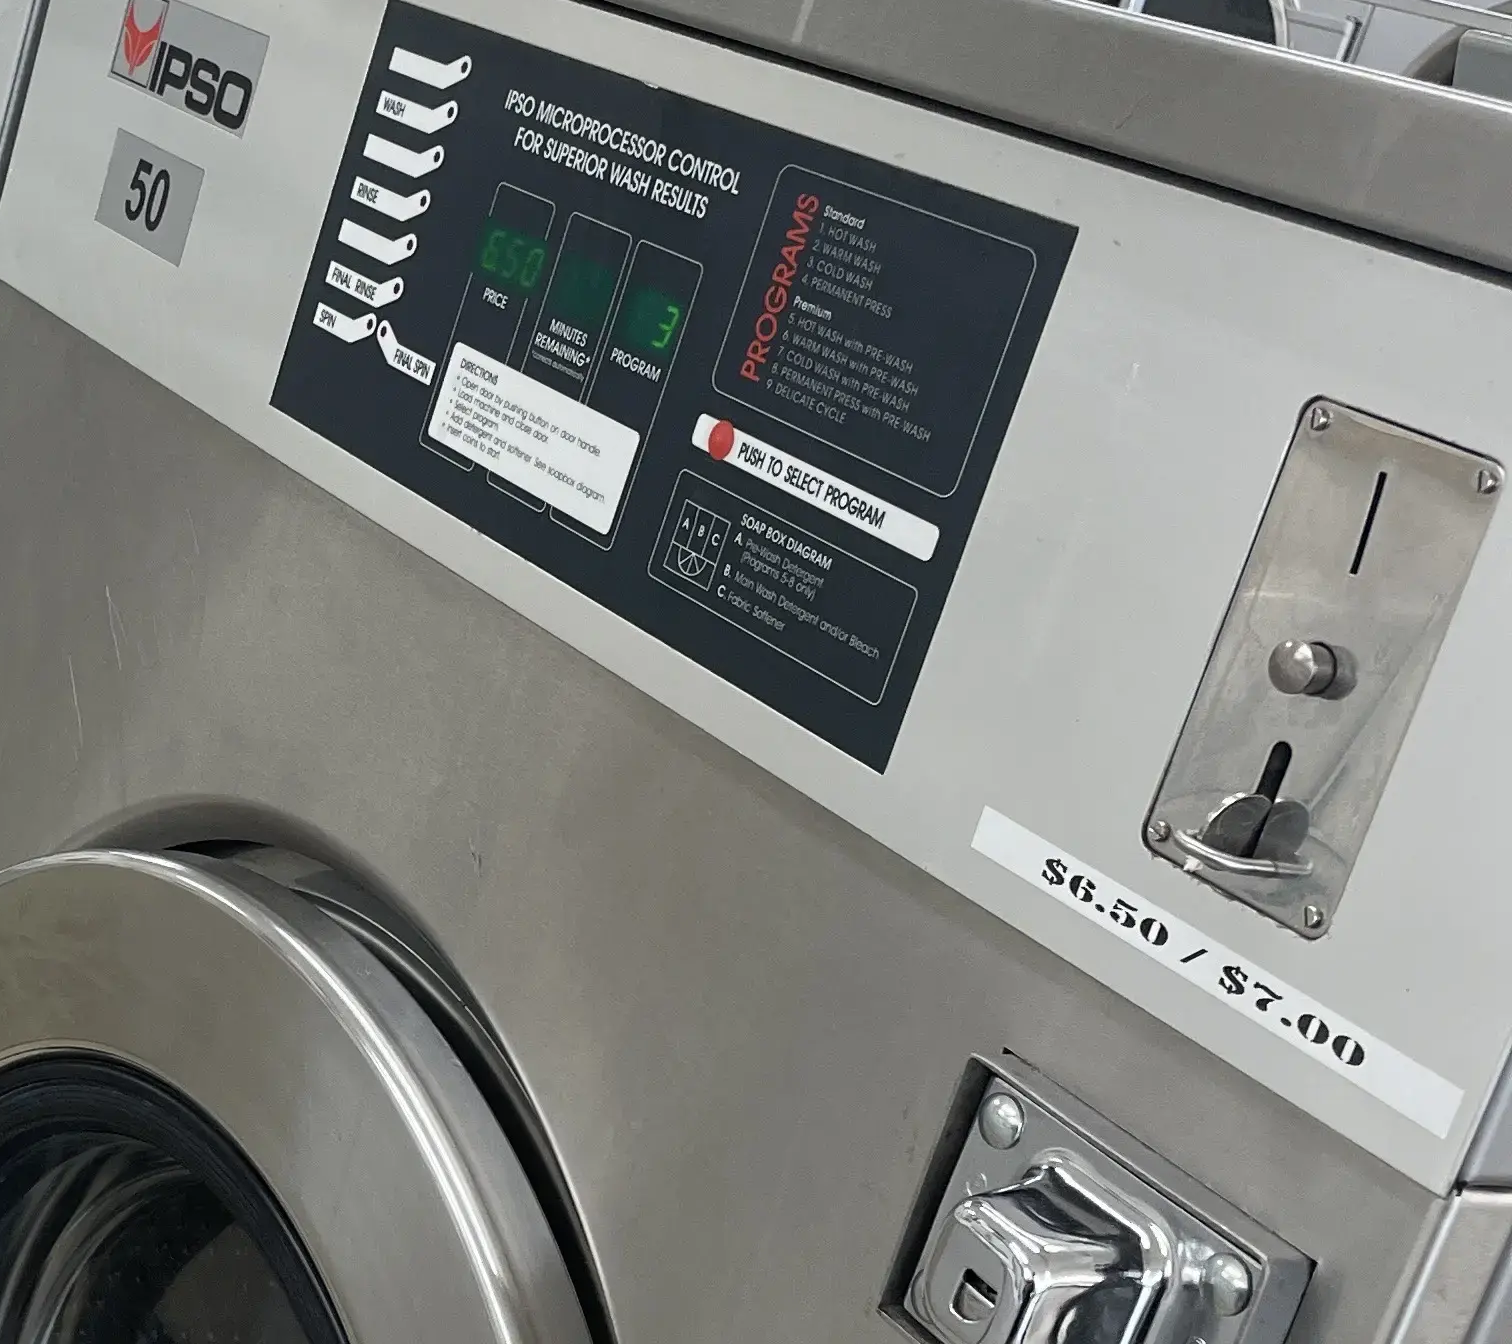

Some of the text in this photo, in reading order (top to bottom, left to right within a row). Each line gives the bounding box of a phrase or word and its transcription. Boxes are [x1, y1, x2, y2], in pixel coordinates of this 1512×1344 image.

[148, 41, 253, 131] IPSO
[382, 97, 405, 117] WASH
[504, 89, 743, 194] IPSO MICROPROCESSOR CONTROL
[514, 127, 709, 218] FOR SUPERIOR WASH RESULTS
[124, 158, 171, 233] 50
[357, 183, 378, 202] RINSE
[823, 205, 865, 229] Standard
[827, 225, 848, 242] HOT
[847, 233, 877, 253] WASH
[816, 259, 845, 279] COLD
[845, 271, 873, 290] WASH
[821, 243, 852, 263] WARM
[852, 254, 881, 274] WASH
[331, 267, 376, 300] FINAL RINSE
[482, 287, 507, 309] PRICE
[739, 191, 820, 384] PROGRAMS
[810, 277, 864, 306] PERMANENT
[864, 298, 892, 318] PRESS
[319, 310, 336, 328] SPIN
[793, 295, 833, 320] Premium
[549, 318, 588, 347] MINUTES
[651, 303, 680, 351] 3
[797, 316, 816, 333] HOT
[816, 324, 843, 344] WASH
[844, 336, 864, 353] with
[864, 345, 913, 373] PRE-WASH
[393, 349, 430, 378] FINAL SPIN
[460, 358, 498, 385] DIRECTIONS
[610, 347, 660, 382] PROGRAM
[786, 350, 813, 370] COLD
[814, 362, 840, 382] WASH
[840, 374, 861, 391] with
[861, 382, 910, 413] PRE-WASH
[791, 333, 821, 354] WARM
[821, 346, 848, 366] WASH
[848, 357, 868, 375] with
[869, 366, 918, 396] PRE-WASH
[458, 389, 472, 403] Load
[473, 397, 500, 418] machine
[501, 412, 514, 425] and
[461, 376, 478, 393] Open
[479, 386, 493, 400] door
[494, 395, 503, 406] by
[503, 399, 528, 420] pushing
[528, 412, 549, 429] button
[560, 429, 576, 444] door
[774, 383, 814, 409] DELICATE
[815, 401, 846, 424] CYCLE
[780, 366, 833, 399] PERMANENT
[833, 390, 861, 411] PRESS
[861, 402, 882, 421] with
[882, 411, 931, 443] PRE-WASH
[479, 442, 486, 452] to
[493, 435, 506, 449] and
[738, 442, 885, 528] PUSH TO SELECT PROGRAM
[682, 517, 720, 546] A B C
[740, 513, 832, 570] SOAP BOX DIAGRAM
[745, 539, 781, 565] Pre-Wash
[781, 558, 824, 590] Detergent
[781, 572, 795, 587] 5-8
[727, 590, 752, 613] Fabric
[751, 604, 786, 632] Softener
[734, 572, 754, 590] Main
[755, 583, 777, 602] Wash
[776, 595, 818, 627] Detergent
[819, 617, 849, 642] and/or
[849, 634, 880, 659] Bleach
[1040, 858, 1366, 1069] $6.50 / $7.00
